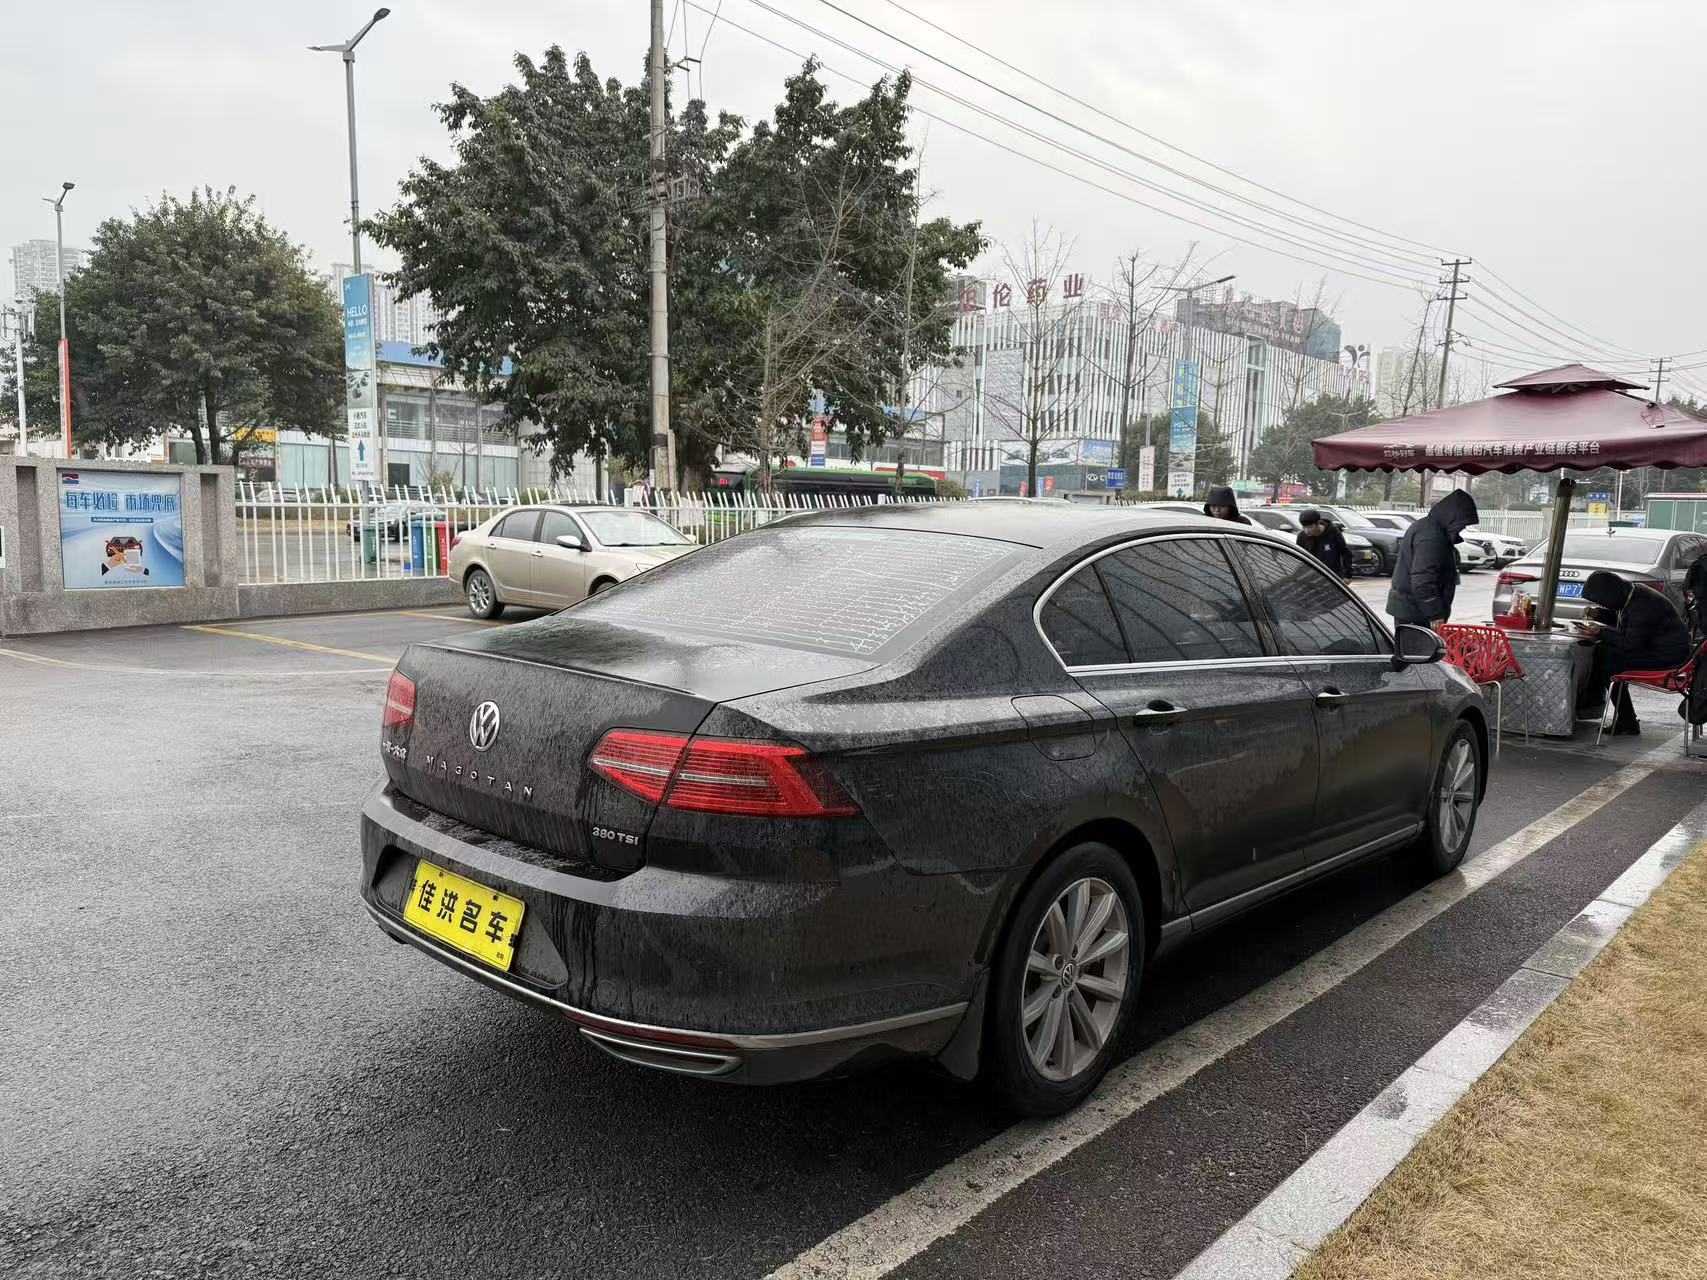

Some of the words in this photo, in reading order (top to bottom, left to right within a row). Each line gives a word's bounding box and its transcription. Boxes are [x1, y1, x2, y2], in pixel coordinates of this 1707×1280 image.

[427, 755, 533, 797] MAGOTAN
[418, 880, 508, 943] 佳洪名车
